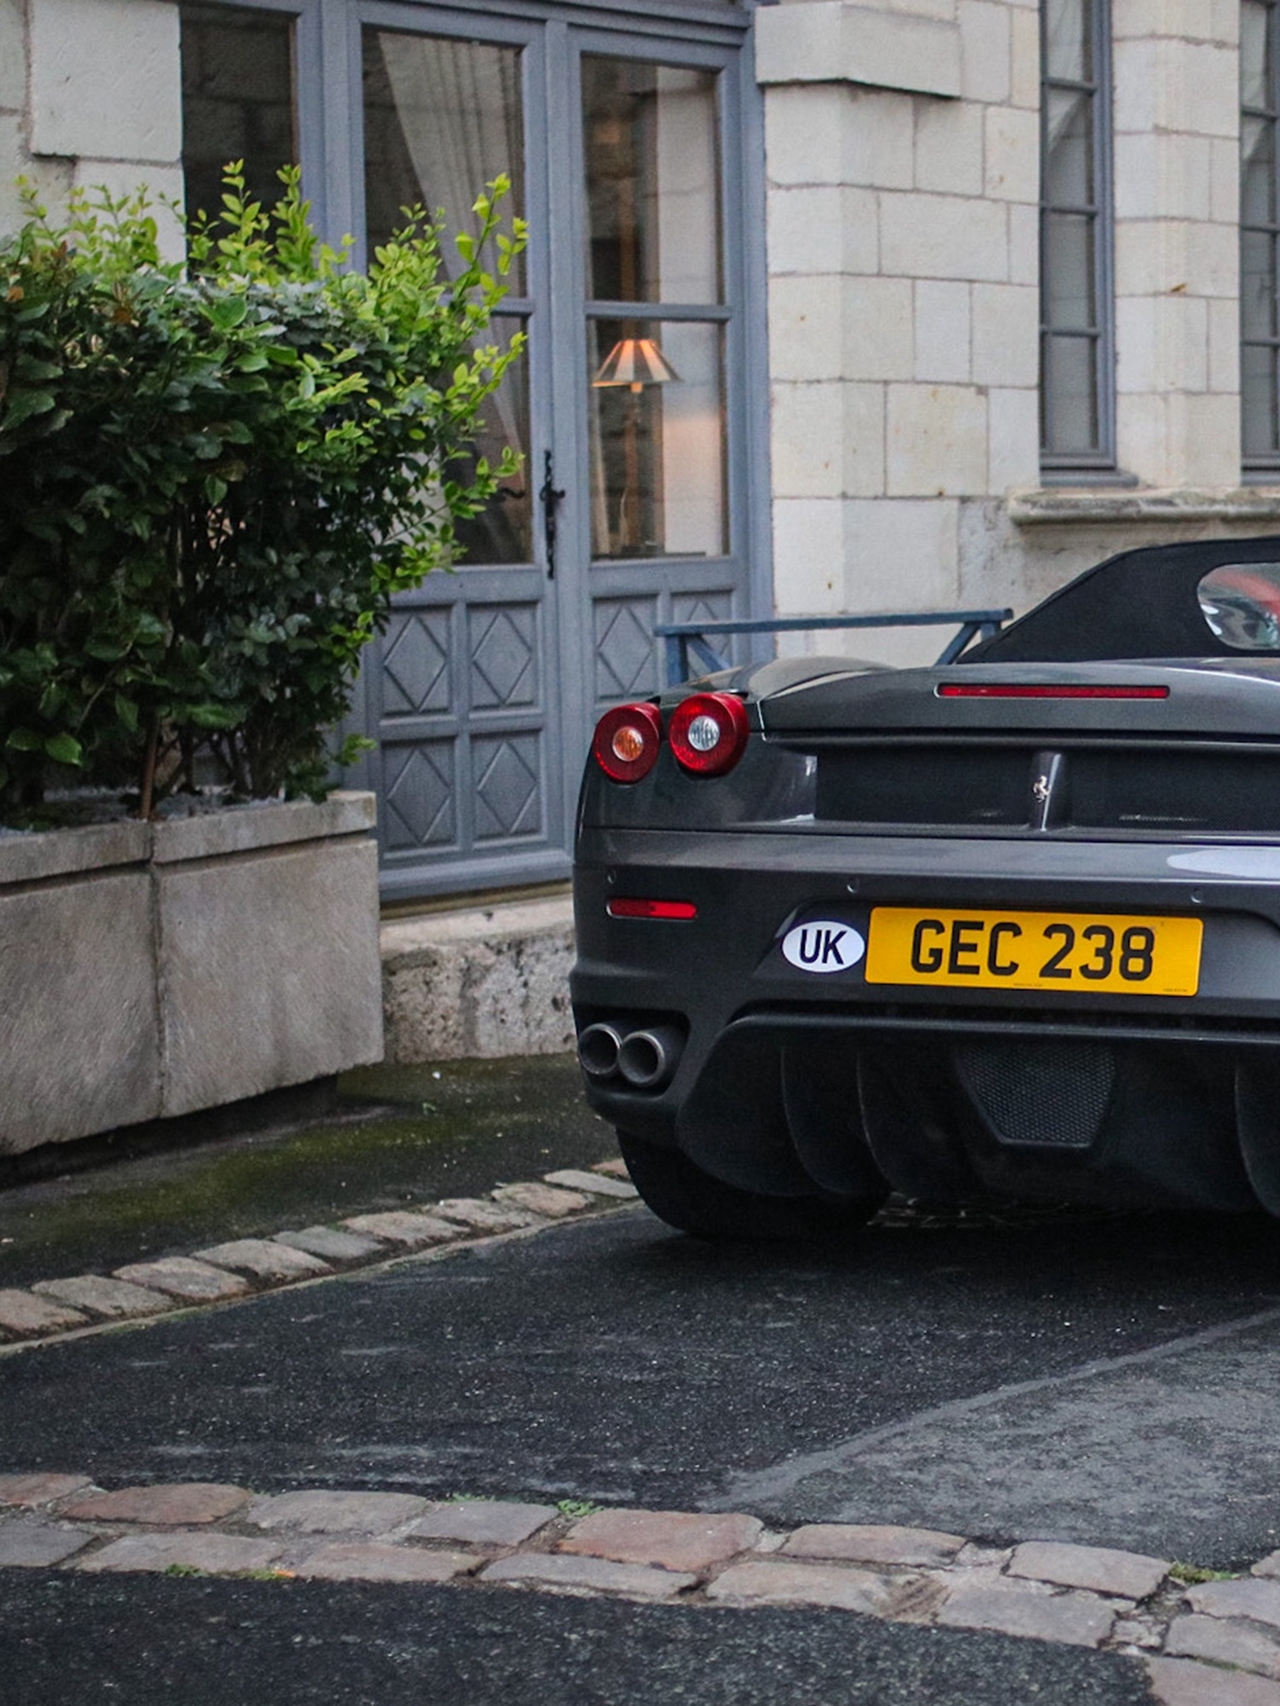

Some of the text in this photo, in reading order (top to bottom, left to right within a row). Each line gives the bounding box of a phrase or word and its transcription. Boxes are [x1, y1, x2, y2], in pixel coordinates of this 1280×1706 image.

[799, 928, 847, 965] UK
[910, 918, 1155, 982] GEC 238
